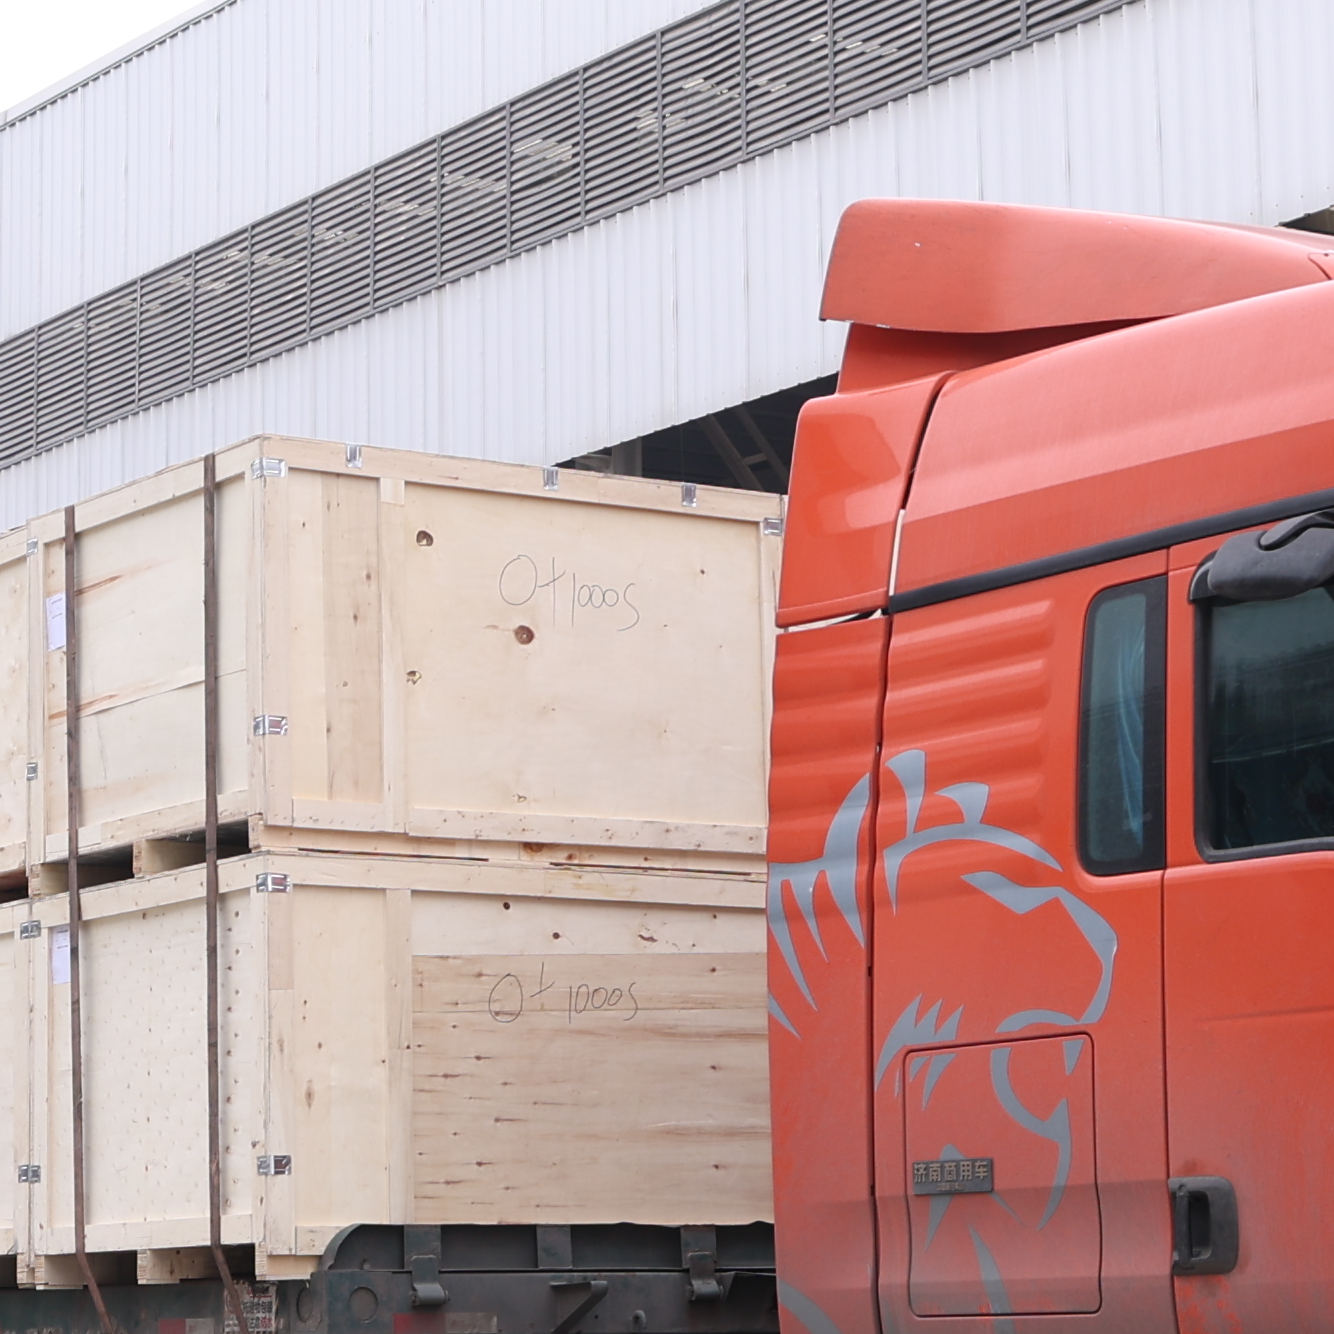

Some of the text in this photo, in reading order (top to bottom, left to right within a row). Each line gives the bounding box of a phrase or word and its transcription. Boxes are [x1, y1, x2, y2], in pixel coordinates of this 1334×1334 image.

[914, 1160, 988, 1183] 济南商用车
